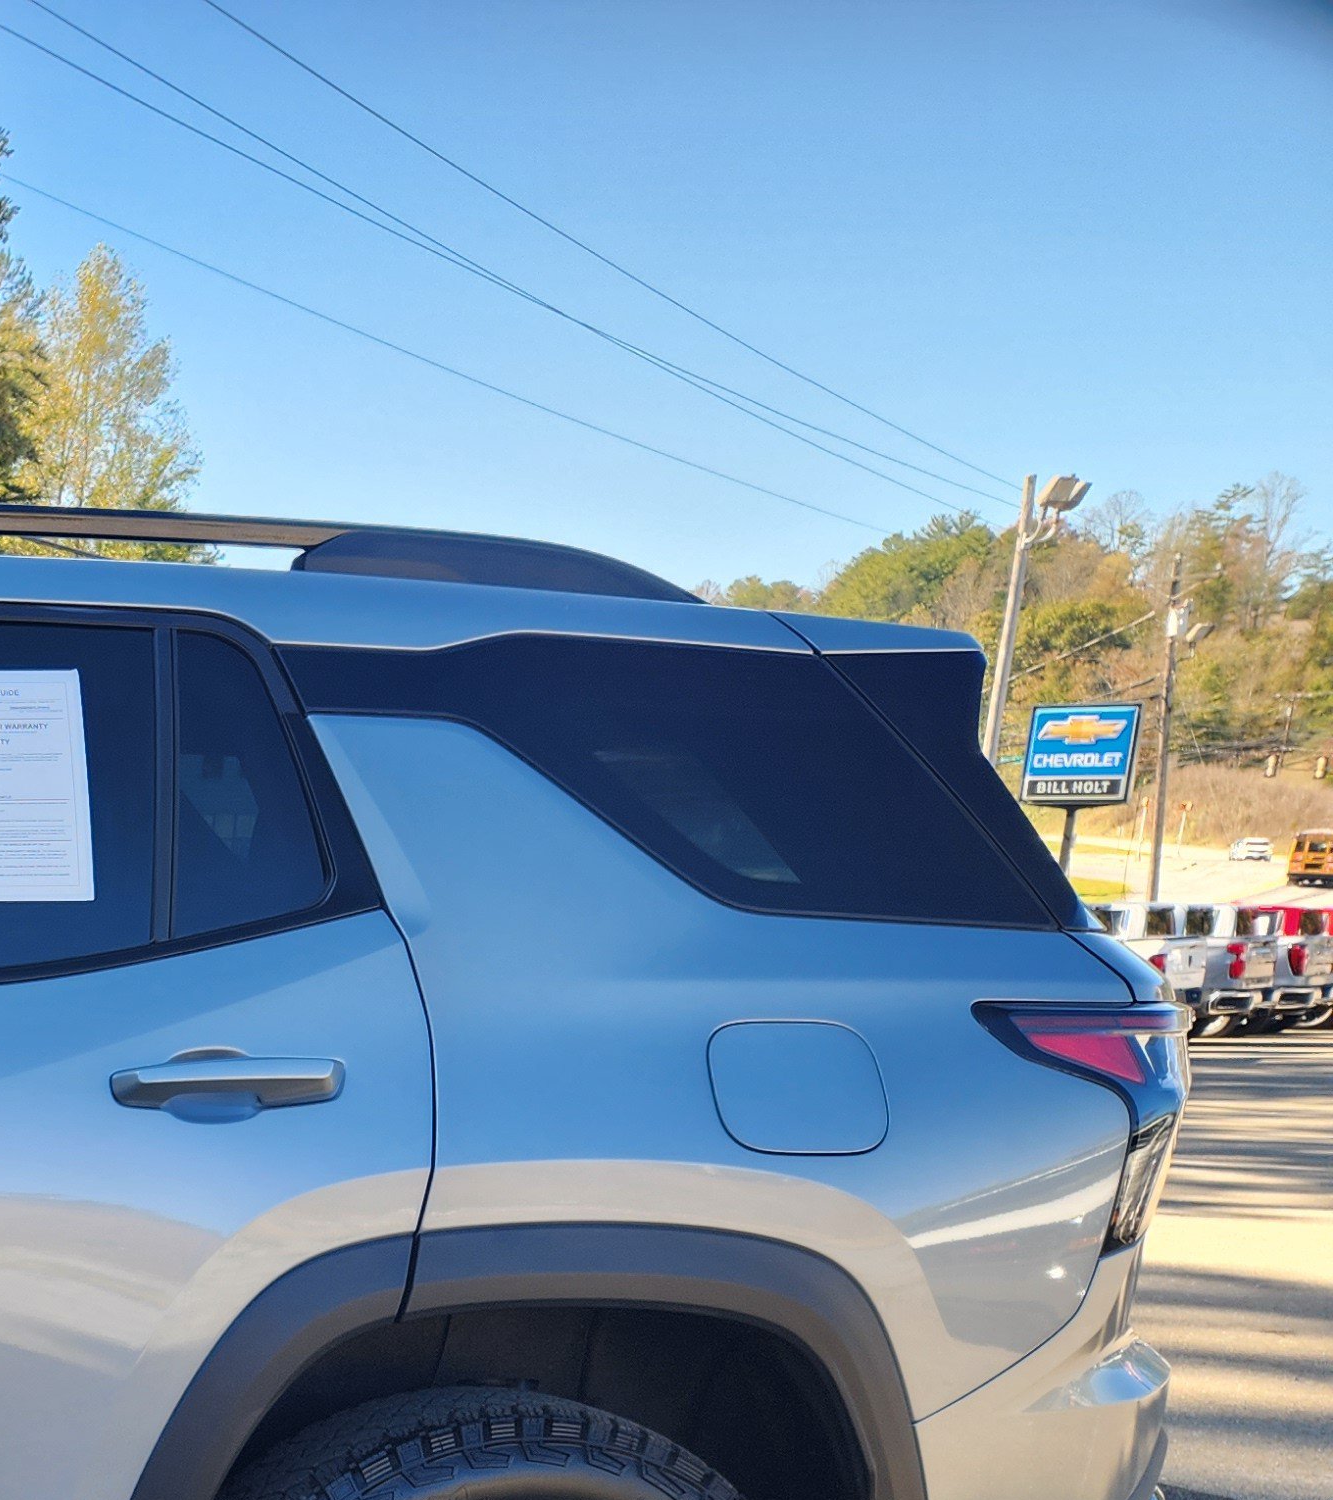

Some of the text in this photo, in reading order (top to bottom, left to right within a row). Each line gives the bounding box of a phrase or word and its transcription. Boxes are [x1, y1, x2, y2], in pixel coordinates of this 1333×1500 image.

[1033, 752, 1123, 769] CHEVROLET
[1036, 780, 1111, 794] BILL HOLT
